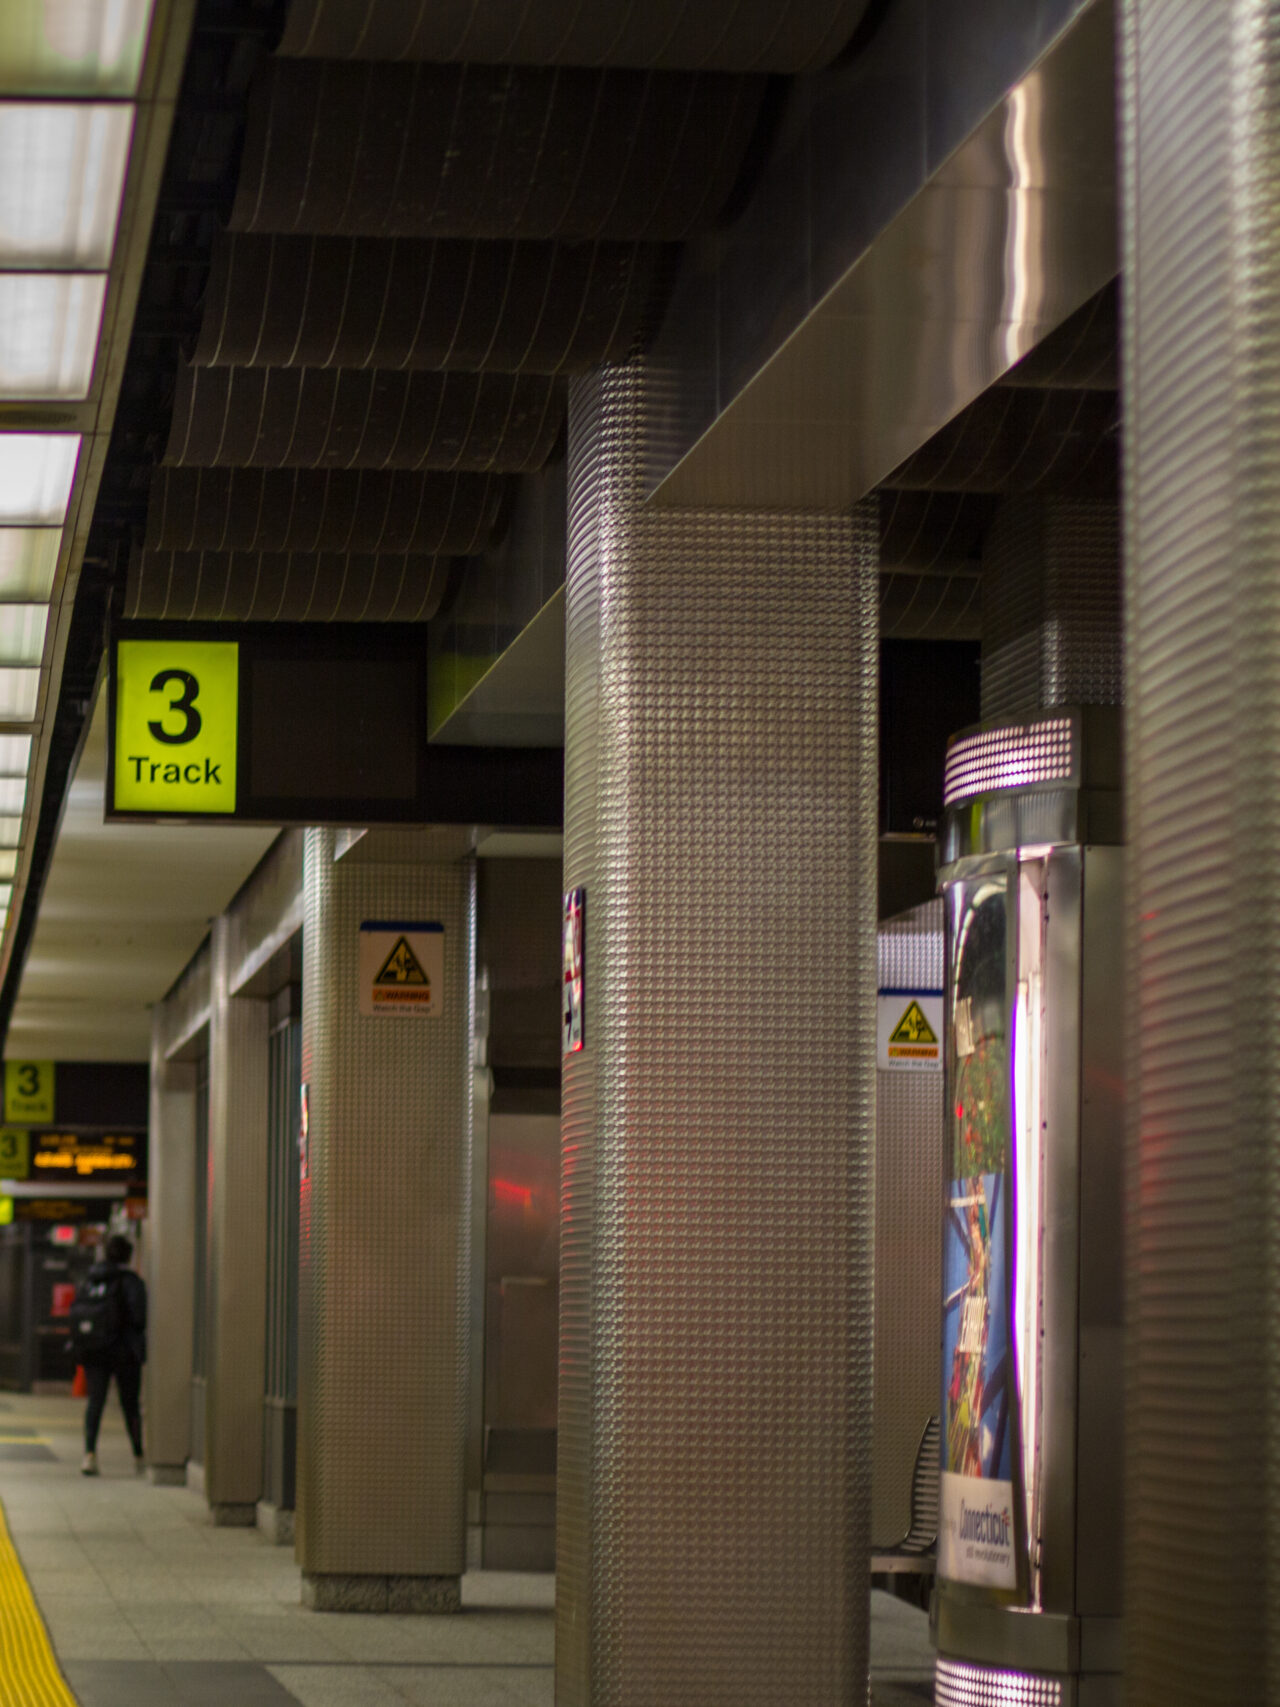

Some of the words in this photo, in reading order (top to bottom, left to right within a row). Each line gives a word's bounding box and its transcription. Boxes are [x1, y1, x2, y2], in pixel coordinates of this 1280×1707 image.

[147, 668, 203, 746] 3
[128, 756, 223, 786] Track
[385, 991, 430, 1001] WARNING
[18, 1064, 40, 1097] 3
[1, 1134, 17, 1158] 3
[960, 1498, 1010, 1547] Connecticut
